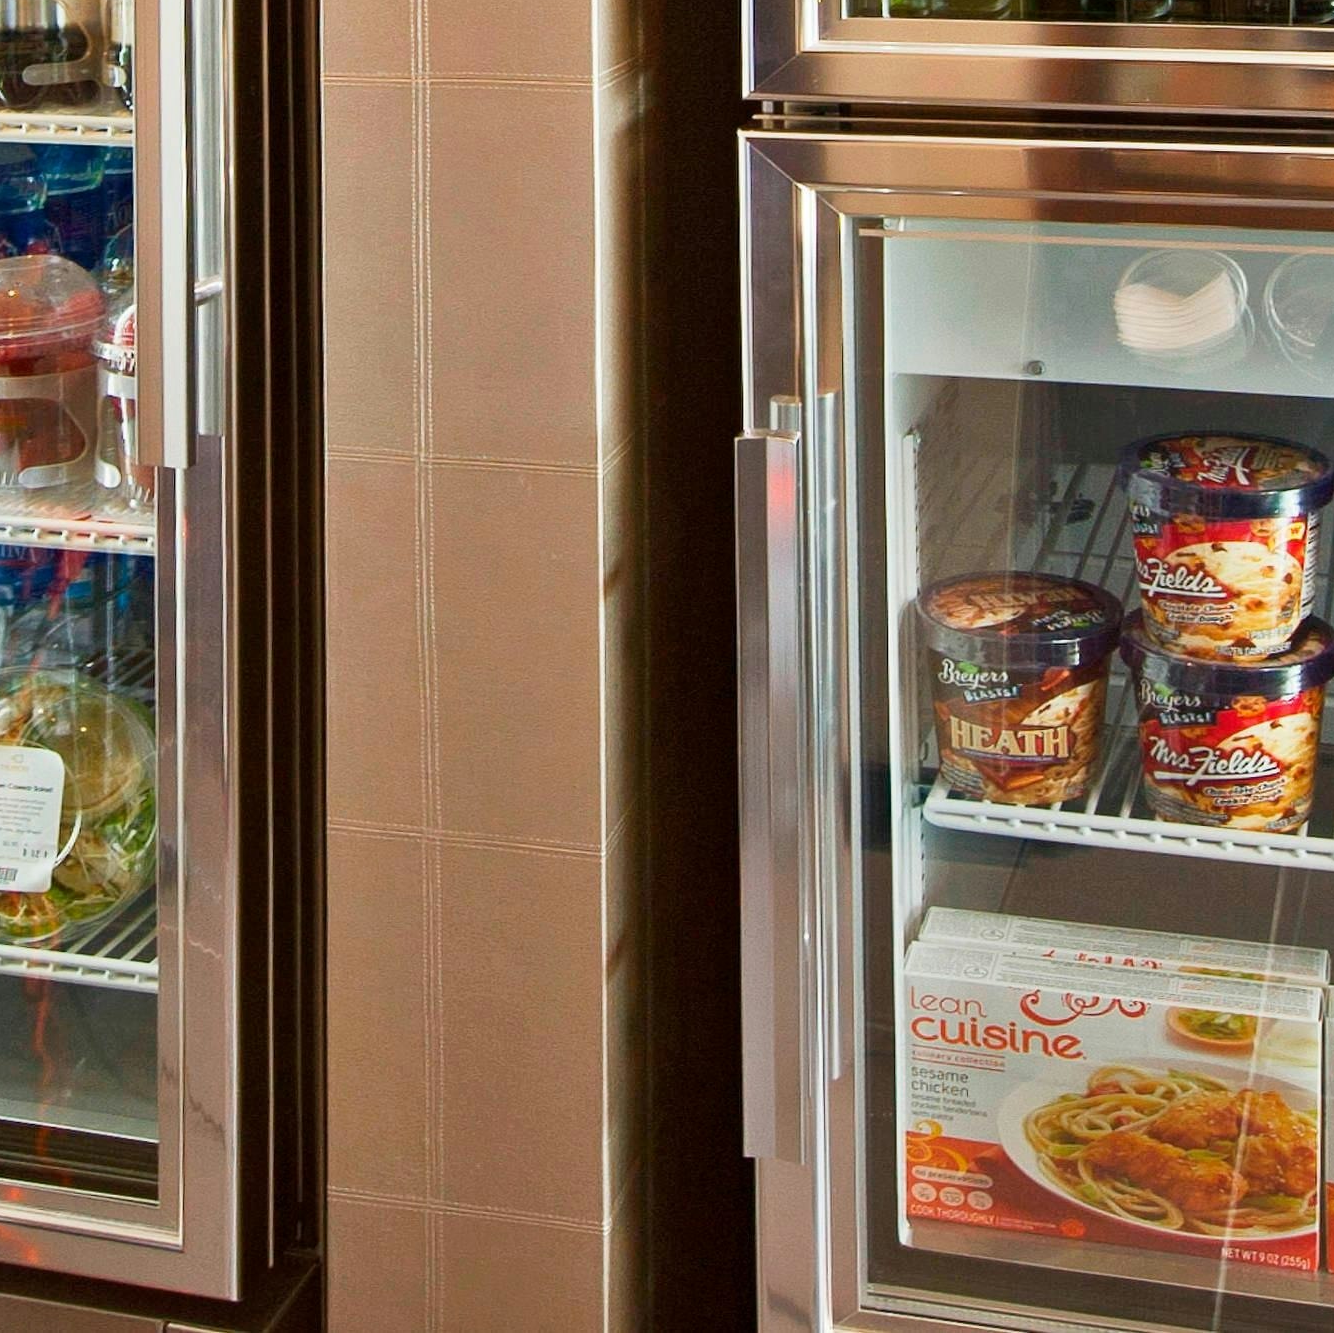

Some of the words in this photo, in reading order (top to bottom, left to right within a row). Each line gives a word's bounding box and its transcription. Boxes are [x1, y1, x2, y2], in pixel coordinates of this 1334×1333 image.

[1147, 557, 1223, 597] Fields
[937, 657, 1010, 686] Breyers
[1139, 679, 1202, 712] Breyers
[949, 715, 1070, 759] HEATH
[1149, 736, 1195, 770] Mrs
[1186, 745, 1280, 786] Fields
[909, 985, 988, 1019] lean
[910, 1016, 1085, 1061] cuisine
[911, 1066, 969, 1084] sesame
[911, 1079, 969, 1098] chicken
[1221, 1246, 1240, 1262] NET
[1241, 1248, 1258, 1263] WT
[1280, 1253, 1312, 1271] (255g)
